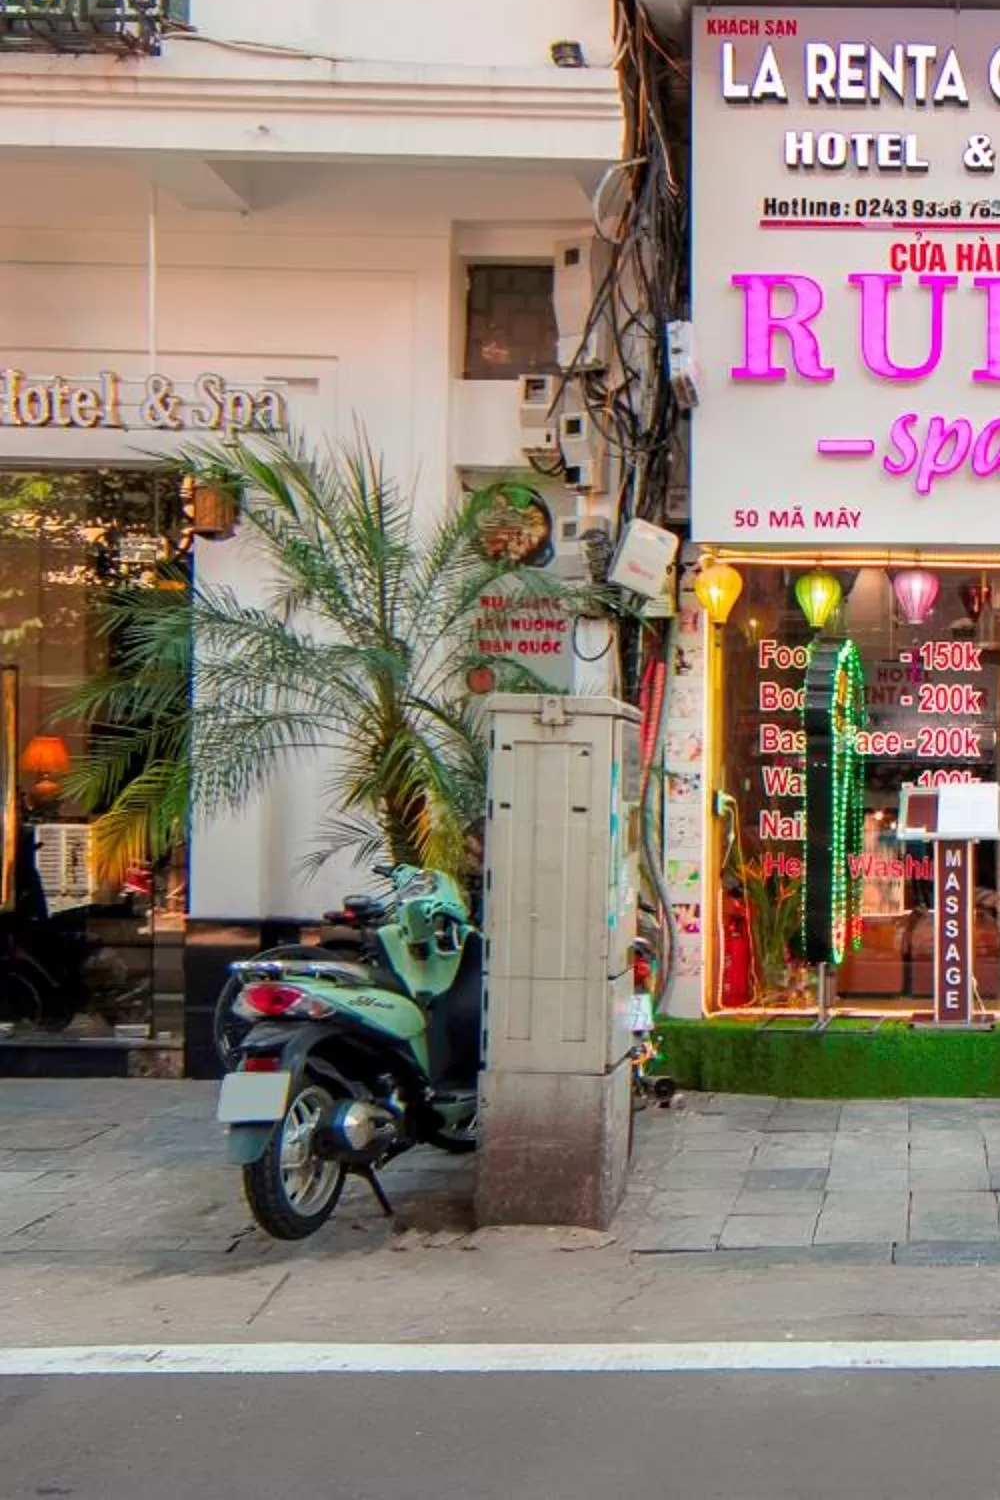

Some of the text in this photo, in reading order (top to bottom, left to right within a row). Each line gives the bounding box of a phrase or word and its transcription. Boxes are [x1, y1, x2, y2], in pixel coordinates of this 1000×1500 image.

[706, 16, 797, 38] KHÁCH SẠN
[721, 42, 788, 104] LA
[805, 41, 969, 107] RENTA
[784, 130, 929, 172] HOTEL
[963, 133, 995, 171] &
[763, 197, 850, 218] Hotline:
[855, 198, 907, 218] 0243
[889, 231, 947, 272] CỬA
[141, 373, 184, 430] &
[192, 372, 287, 447] Spa
[733, 505, 861, 528] 50 MÃ MÂY
[759, 639, 810, 669] Foo
[919, 641, 982, 671] 150k
[918, 684, 982, 713] 200k
[918, 727, 981, 757] 200k
[760, 810, 806, 840] Nai
[944, 849, 961, 1009] MASSAGE
